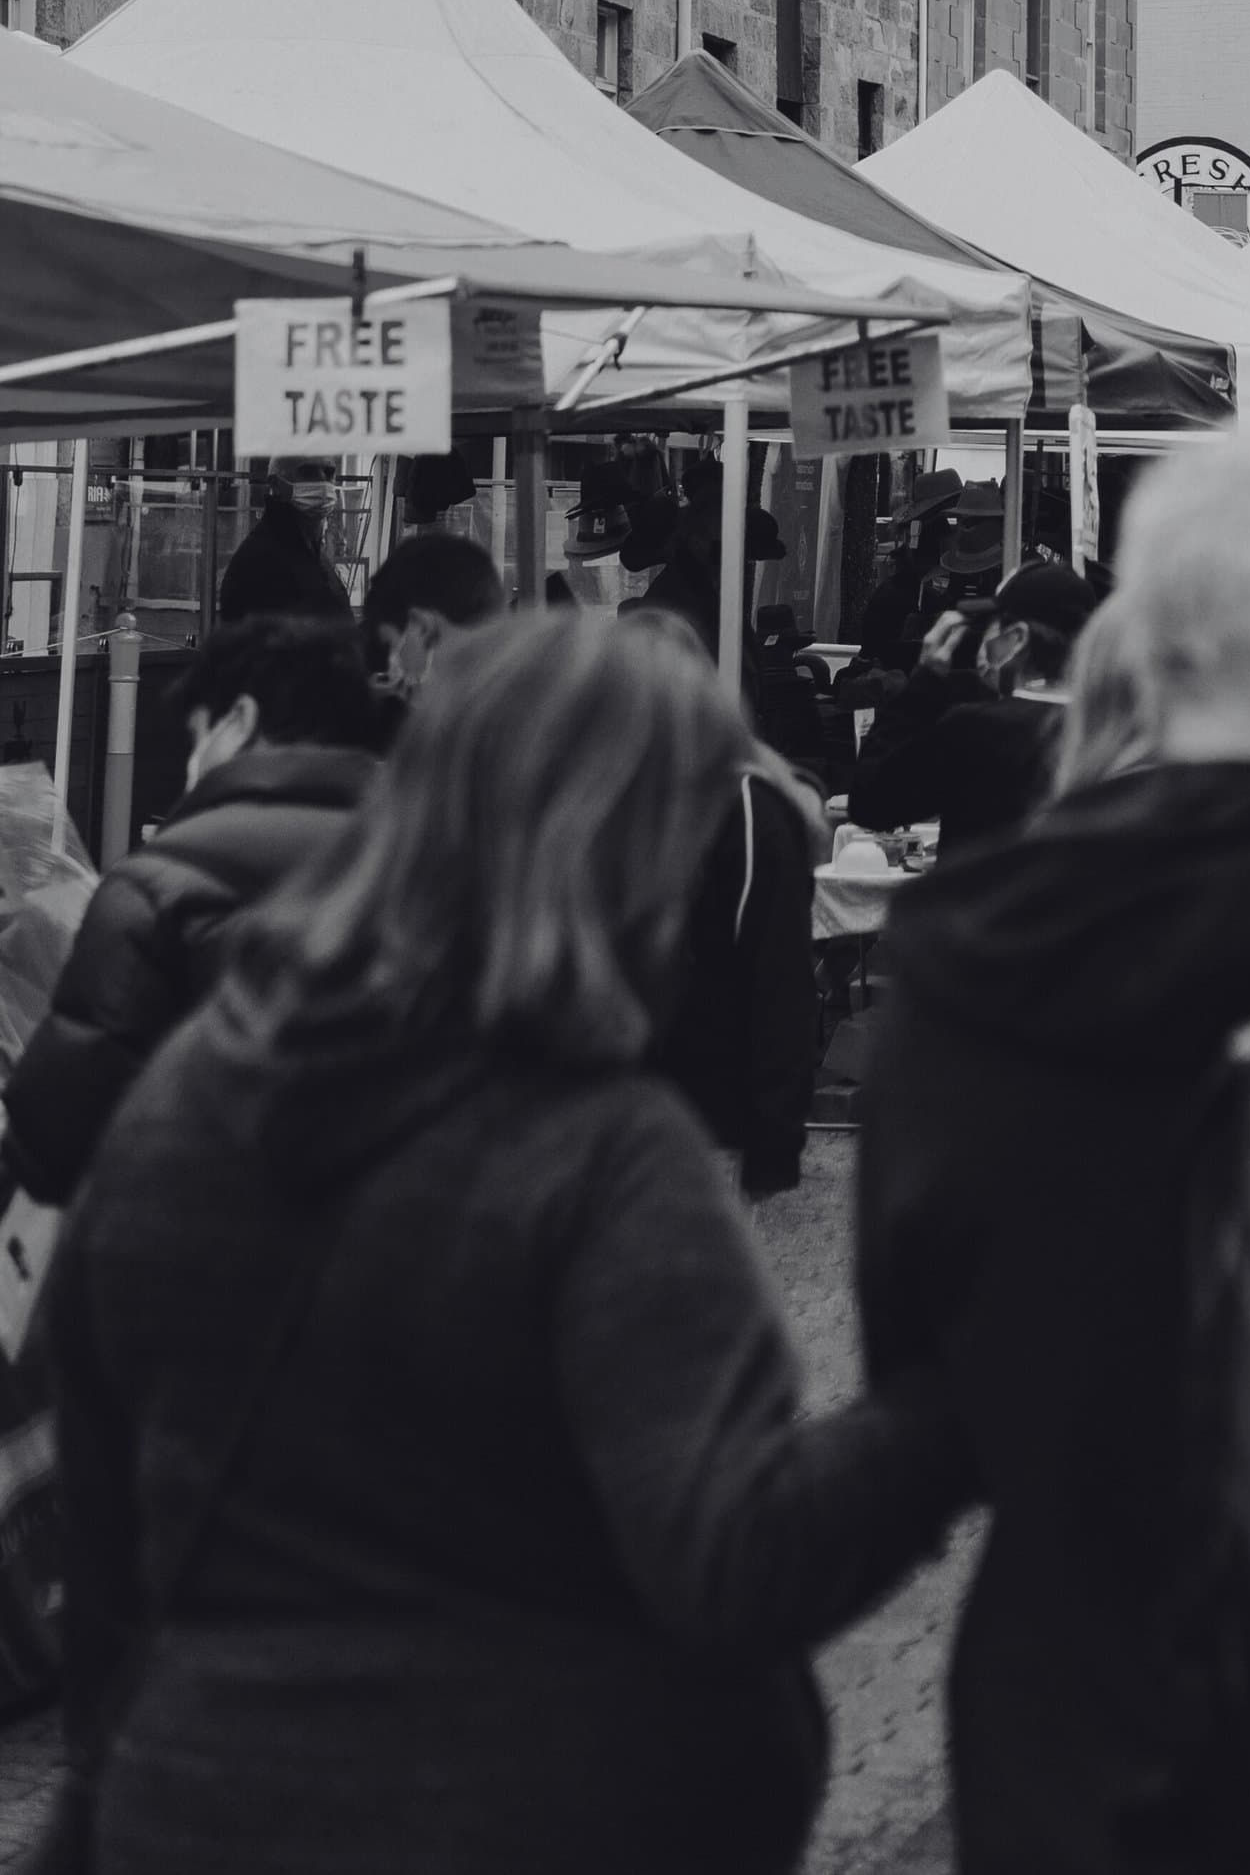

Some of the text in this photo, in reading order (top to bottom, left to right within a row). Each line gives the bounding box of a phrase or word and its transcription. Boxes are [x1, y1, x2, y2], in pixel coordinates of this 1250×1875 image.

[286, 320, 405, 367] FREE
[821, 348, 912, 392] FREE
[284, 390, 404, 434] TASTE
[824, 399, 915, 442] TASTE
